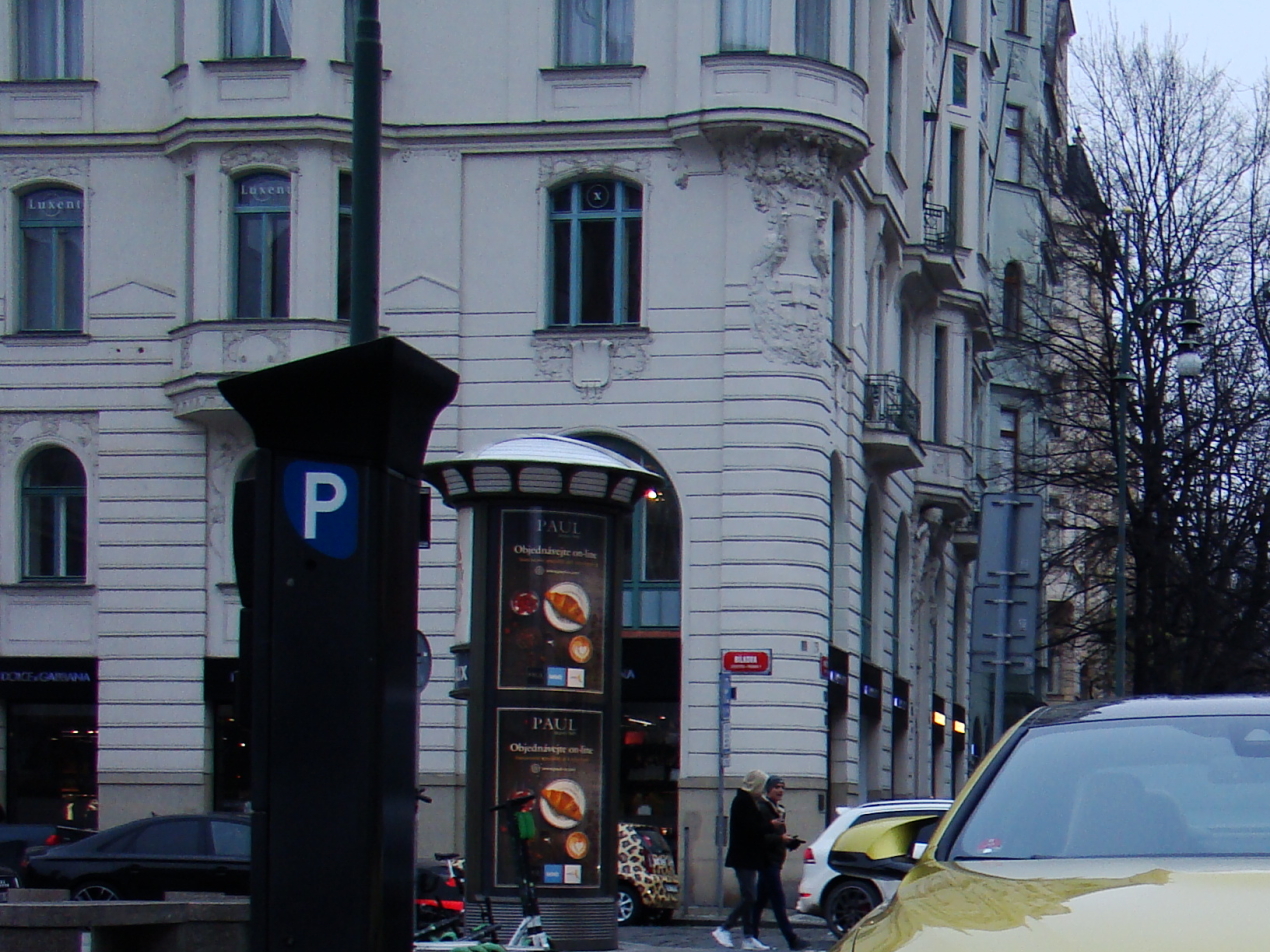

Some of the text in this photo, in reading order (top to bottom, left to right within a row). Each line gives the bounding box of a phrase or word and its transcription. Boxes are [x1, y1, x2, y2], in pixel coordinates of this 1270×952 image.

[304, 471, 348, 540] P
[537, 519, 581, 535] PAUL
[532, 717, 578, 731] PAUL
